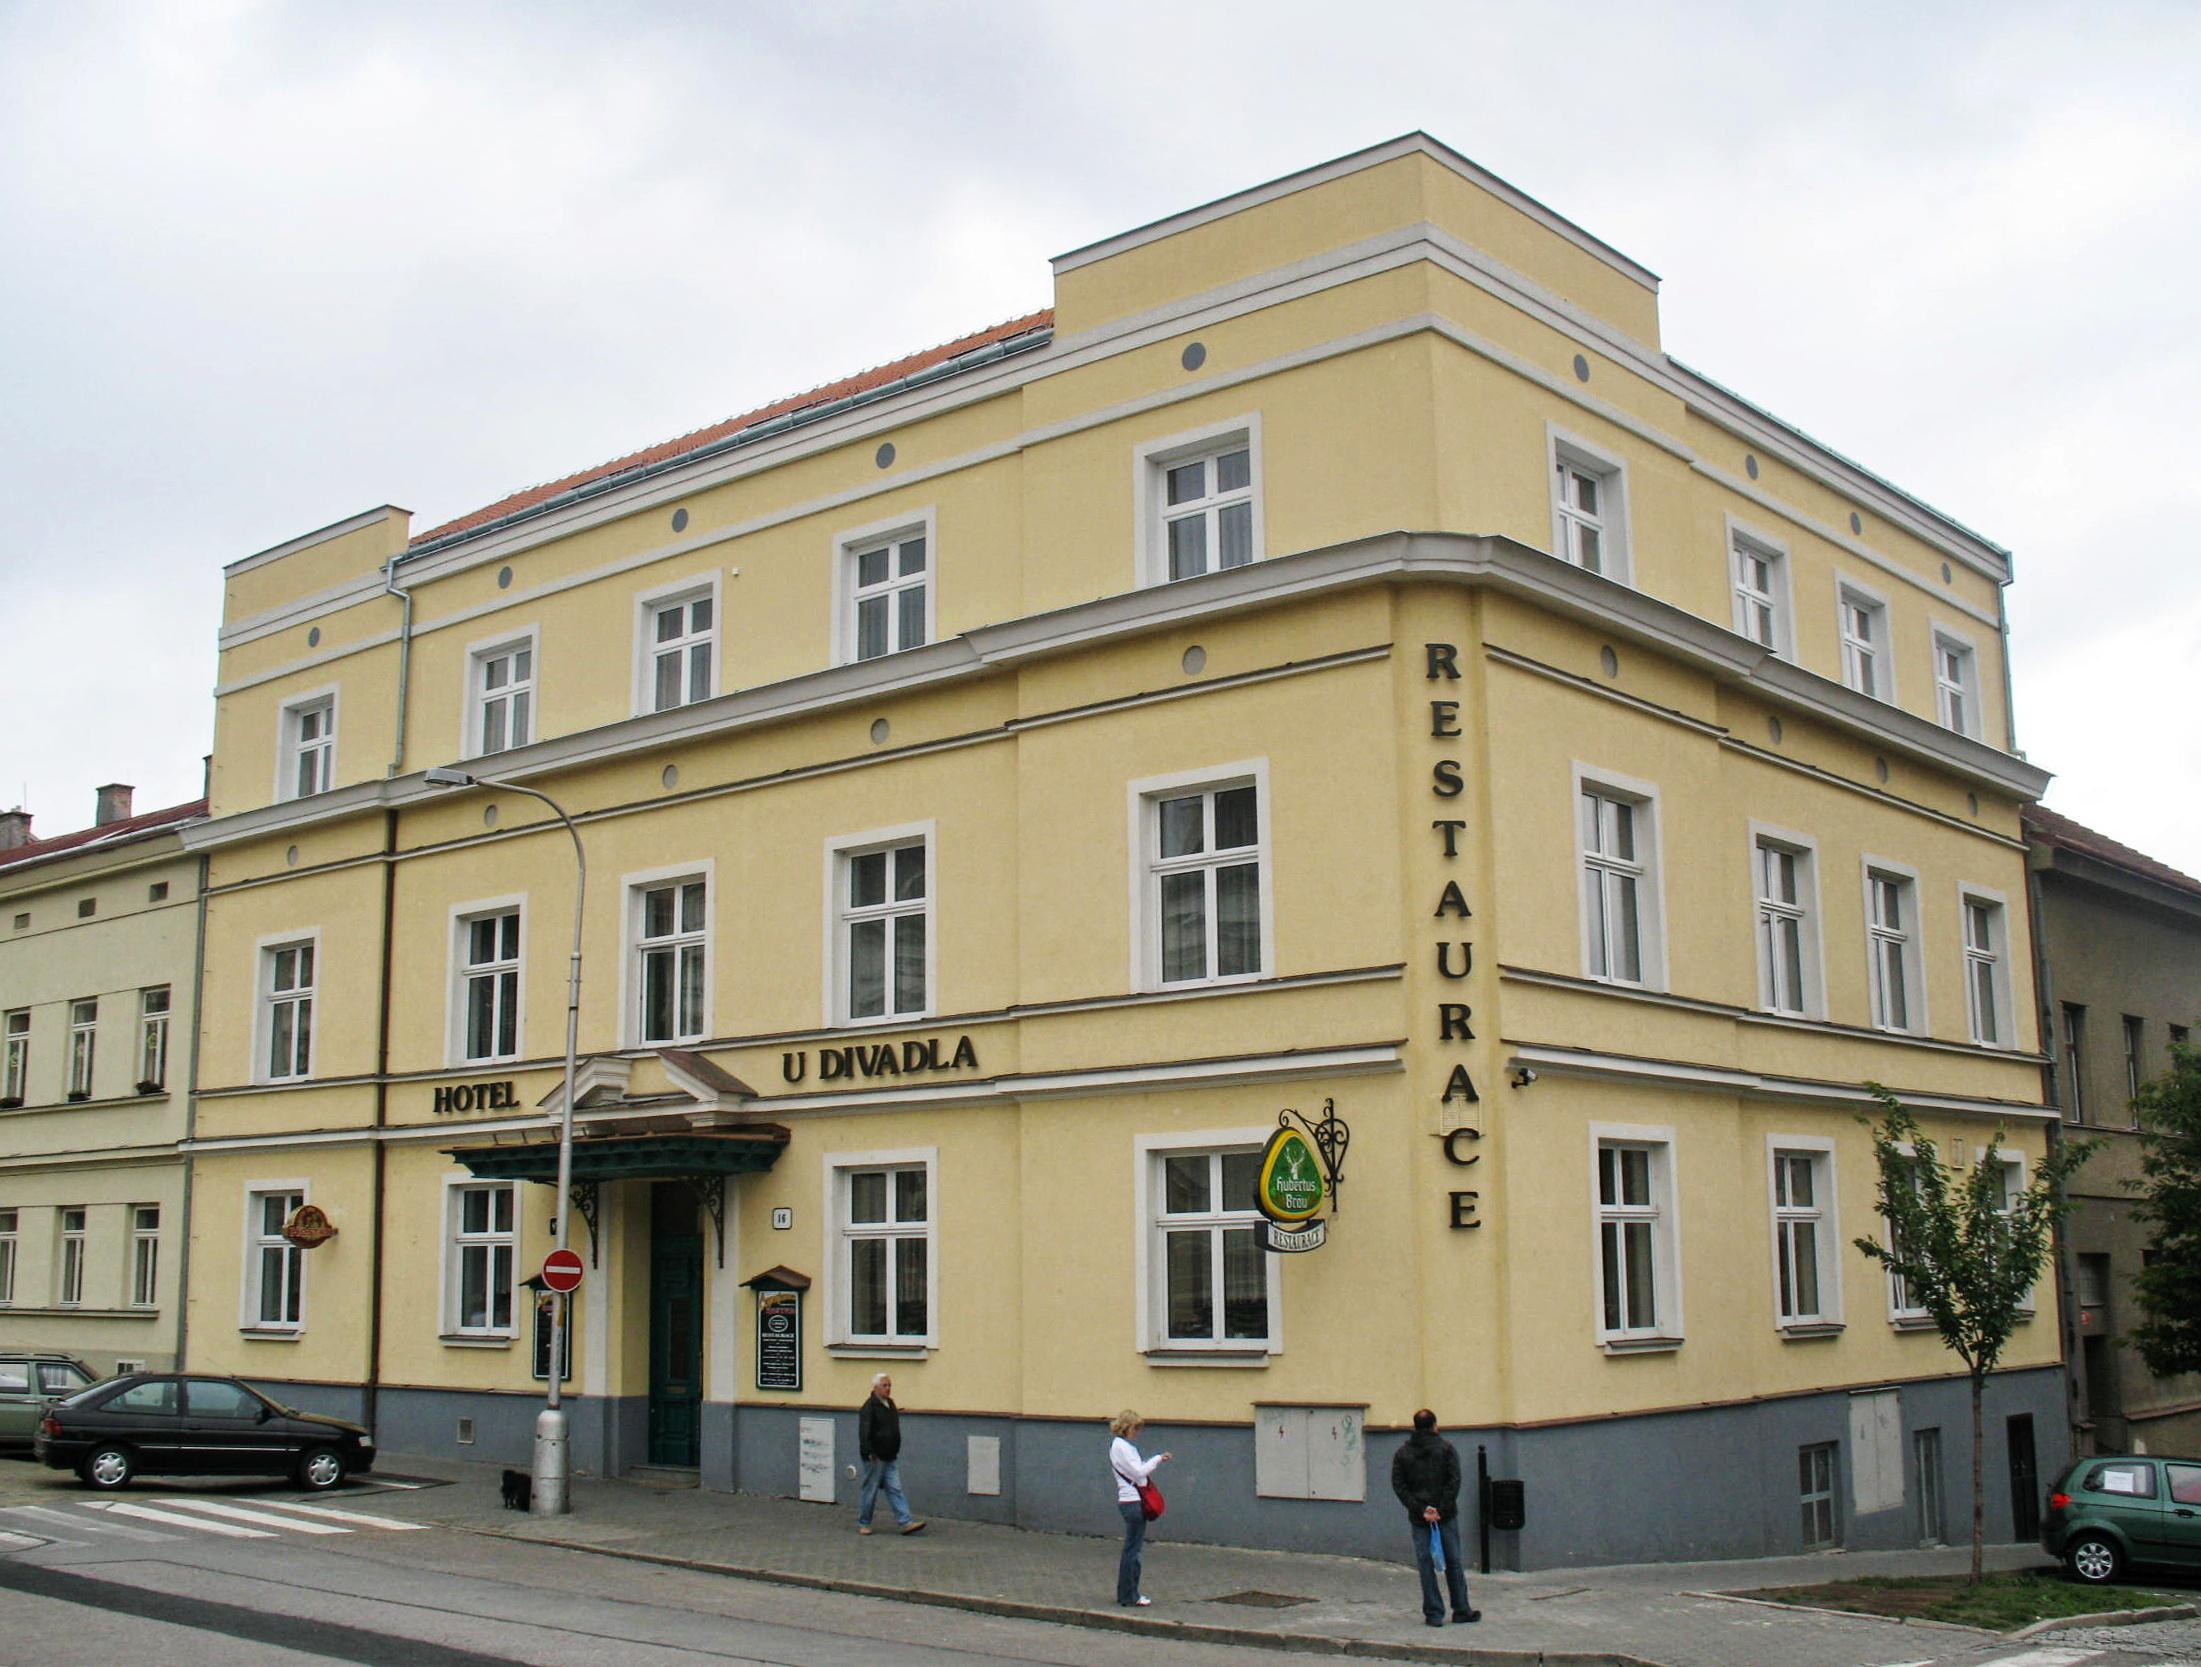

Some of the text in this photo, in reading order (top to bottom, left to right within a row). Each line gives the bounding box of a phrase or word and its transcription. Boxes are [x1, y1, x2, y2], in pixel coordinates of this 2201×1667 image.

[432, 1035, 978, 1113] HOTEL U DIVADLA
[1425, 642, 1482, 1230] RESTAURACE
